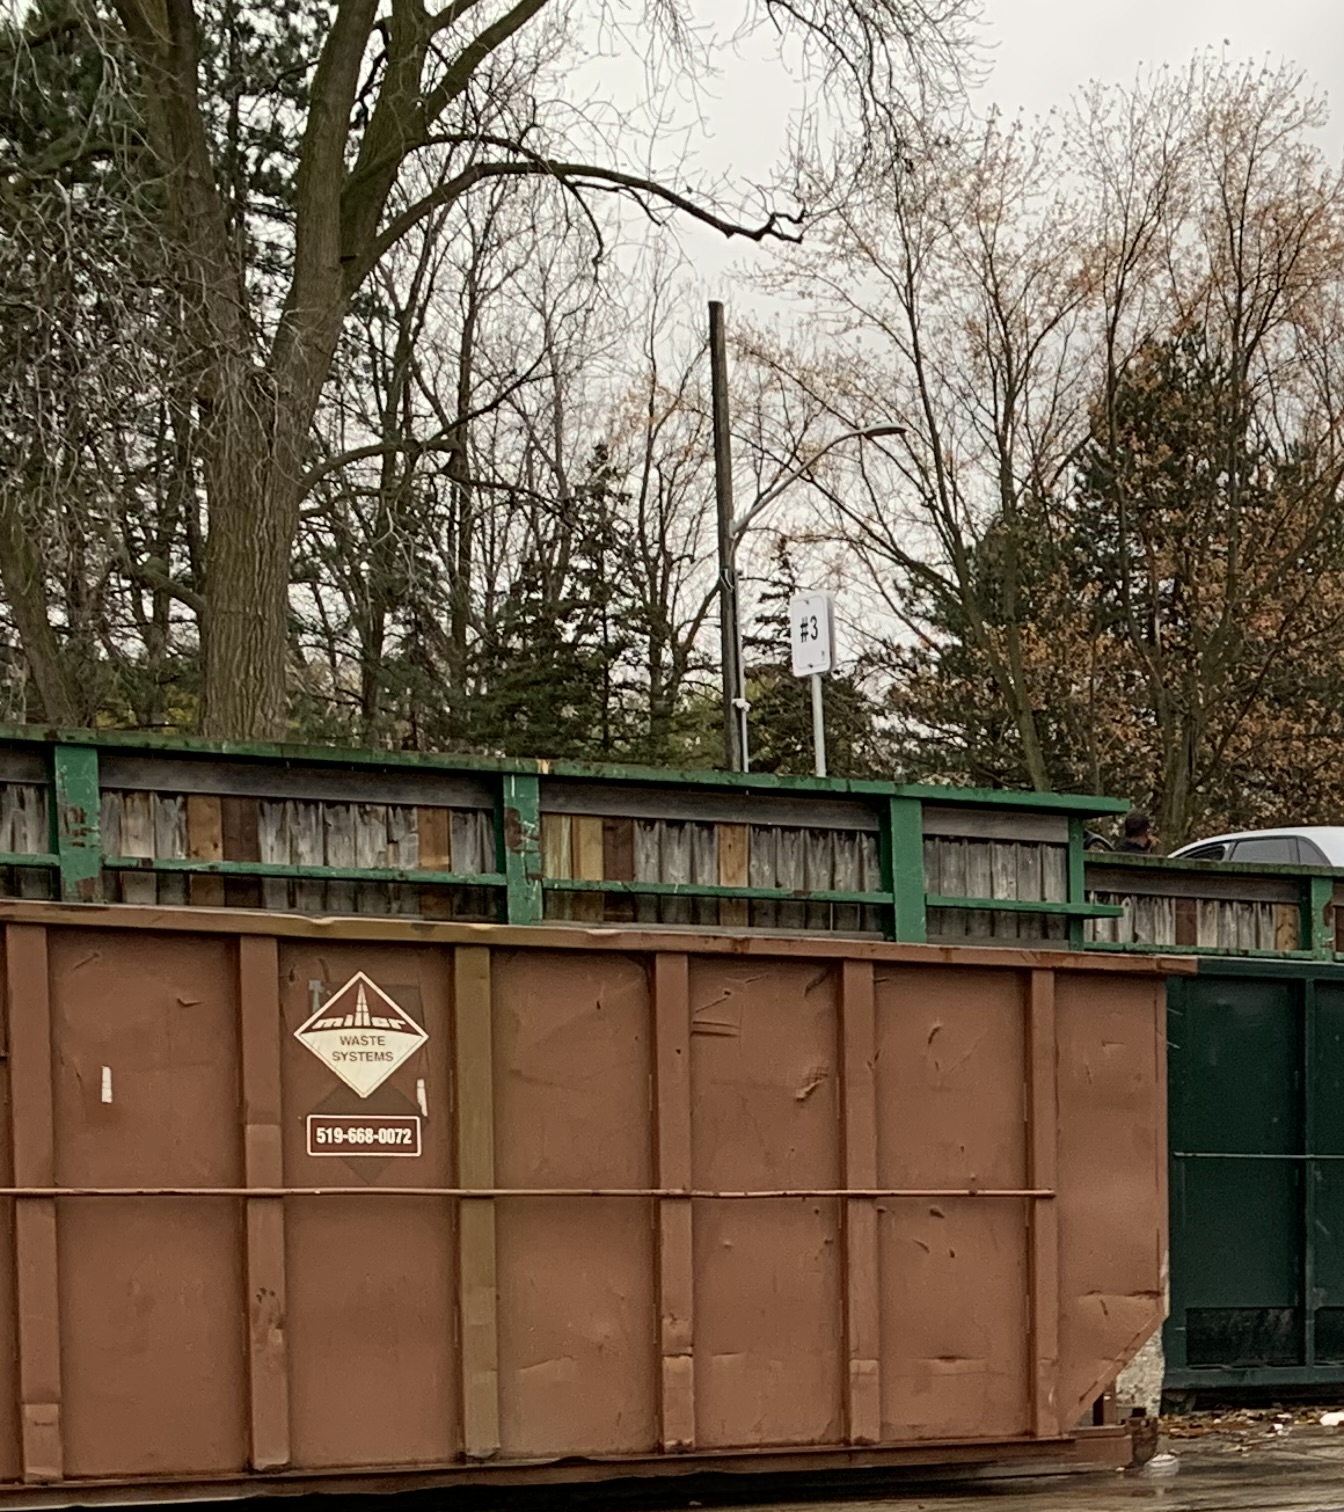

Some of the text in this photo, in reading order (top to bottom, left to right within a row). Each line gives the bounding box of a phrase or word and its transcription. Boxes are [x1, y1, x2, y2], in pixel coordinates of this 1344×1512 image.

[800, 615, 819, 643] #3
[340, 1035, 386, 1046] WASTE
[332, 1051, 394, 1062] SYSTEMS
[316, 1127, 412, 1144] 519-668-0072
